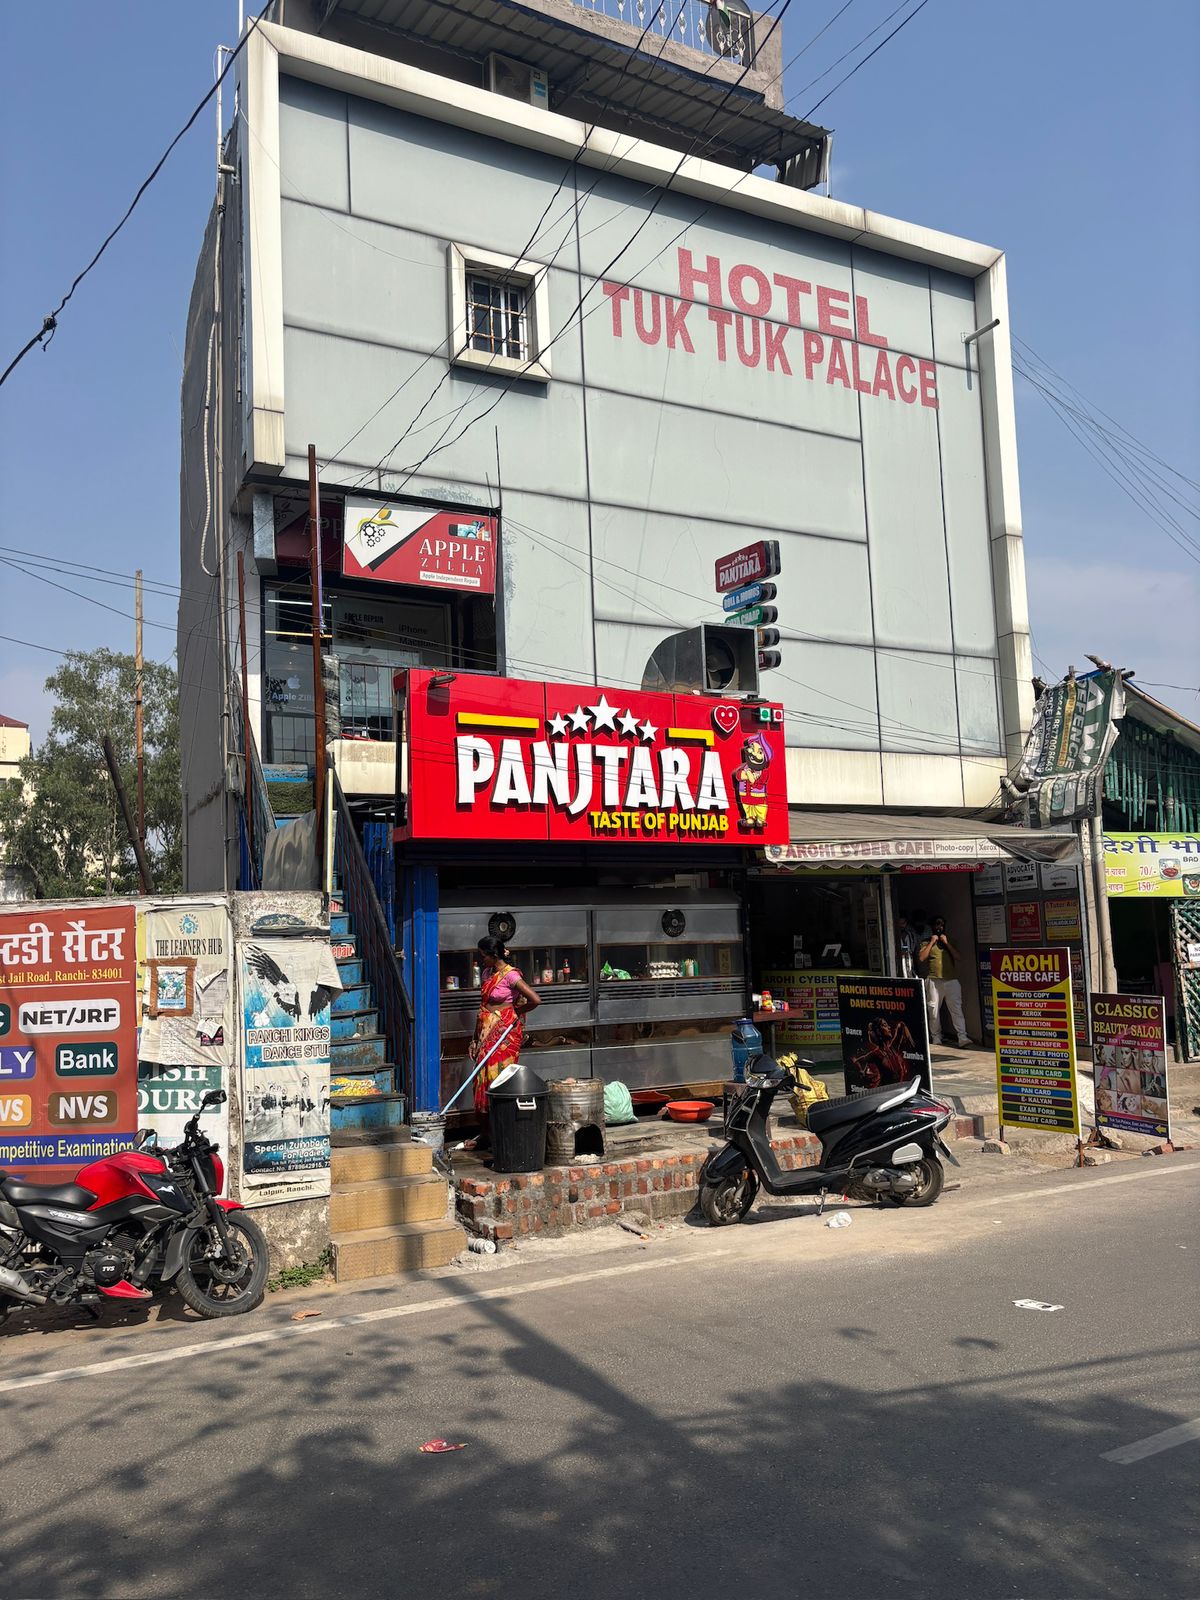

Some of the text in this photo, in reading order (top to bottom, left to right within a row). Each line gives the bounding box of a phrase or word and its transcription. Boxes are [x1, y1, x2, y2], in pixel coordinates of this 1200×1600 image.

[678, 247, 888, 348] HOTEL
[602, 282, 939, 410] TUK TUK PALACE
[419, 539, 486, 562] APPLE
[421, 557, 482, 575] ZILLA
[720, 556, 761, 587] PANJTARA
[272, 693, 297, 701] Apple
[455, 734, 731, 815] PANJTARA
[591, 812, 730, 832] TASTE OF PUNJAB
[786, 841, 933, 858] AROHI CYBER CAFE
[978, 843, 998, 851] Xerox
[1007, 863, 1035, 873] ADVOCATE
[0, 920, 126, 965] टडी सेंटर
[156, 938, 223, 956] THE LEARNER'S HUB
[1000, 954, 1060, 972] AROHI
[8, 972, 25, 983] Jail
[27, 971, 53, 983] Road,
[55, 969, 90, 981] Ranchi-
[92, 967, 123, 979] 834001
[799, 975, 835, 984] CYBER
[1000, 971, 1061, 982] CYBER CAFE
[840, 984, 916, 998] RANCHI KINGS UNIT
[850, 999, 875, 1008] DANCE
[876, 1000, 906, 1011] STUDIO
[1094, 1002, 1159, 1020] CLASSIC
[22, 1007, 117, 1026] NET/JRF
[248, 1026, 330, 1045] RANCHI KINGS
[845, 1026, 863, 1036] Dance
[1093, 1021, 1162, 1039] BEAUTY SALON
[1001, 1048, 1031, 1056] PASSPORT
[1029, 1040, 1061, 1048] TRANSFER
[60, 1048, 115, 1070] Bank
[263, 1045, 302, 1060] DANCE
[902, 1050, 924, 1061] Zumba
[59, 1095, 108, 1119] NVS
[1019, 1105, 1037, 1113] EXAM
[1028, 1097, 1053, 1105] KALYAN
[1018, 1115, 1058, 1125] SMART CARD
[254, 1142, 288, 1155] Special
[289, 1138, 321, 1150] Zumba
[282, 1148, 325, 1160] For Ladies
[250, 1166, 275, 1174] Contact
